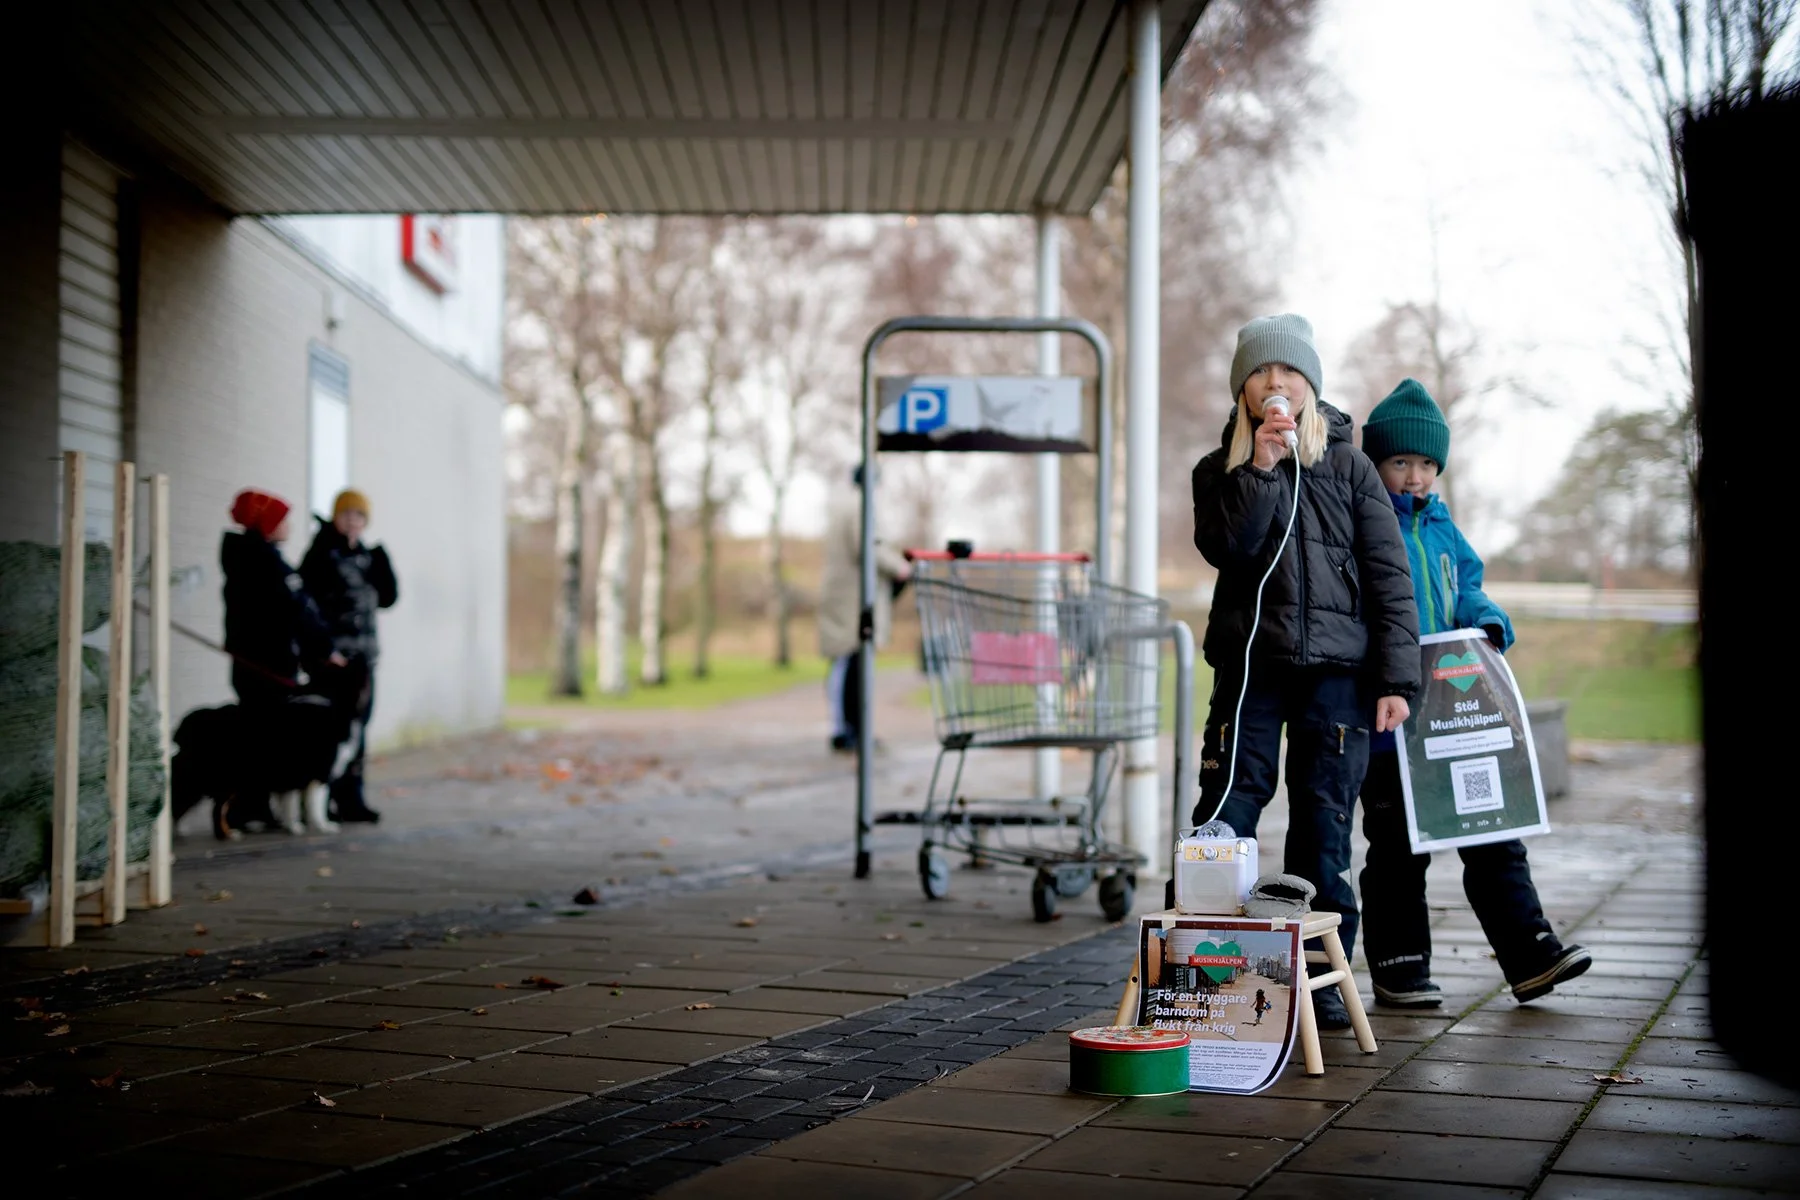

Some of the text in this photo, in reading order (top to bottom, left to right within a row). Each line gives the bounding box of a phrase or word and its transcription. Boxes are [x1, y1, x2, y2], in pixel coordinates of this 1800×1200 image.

[906, 390, 941, 432] P
[1454, 699, 1479, 713] Stöd
[1430, 711, 1503, 732] Musikhjälpen!
[1193, 956, 1243, 965] MUSIKHJÄLPEN
[1157, 988, 1248, 1005] För en tryggare
[1155, 1005, 1226, 1019] barndom på
[1184, 1020, 1210, 1033] från
[1212, 1022, 1237, 1035] krig
